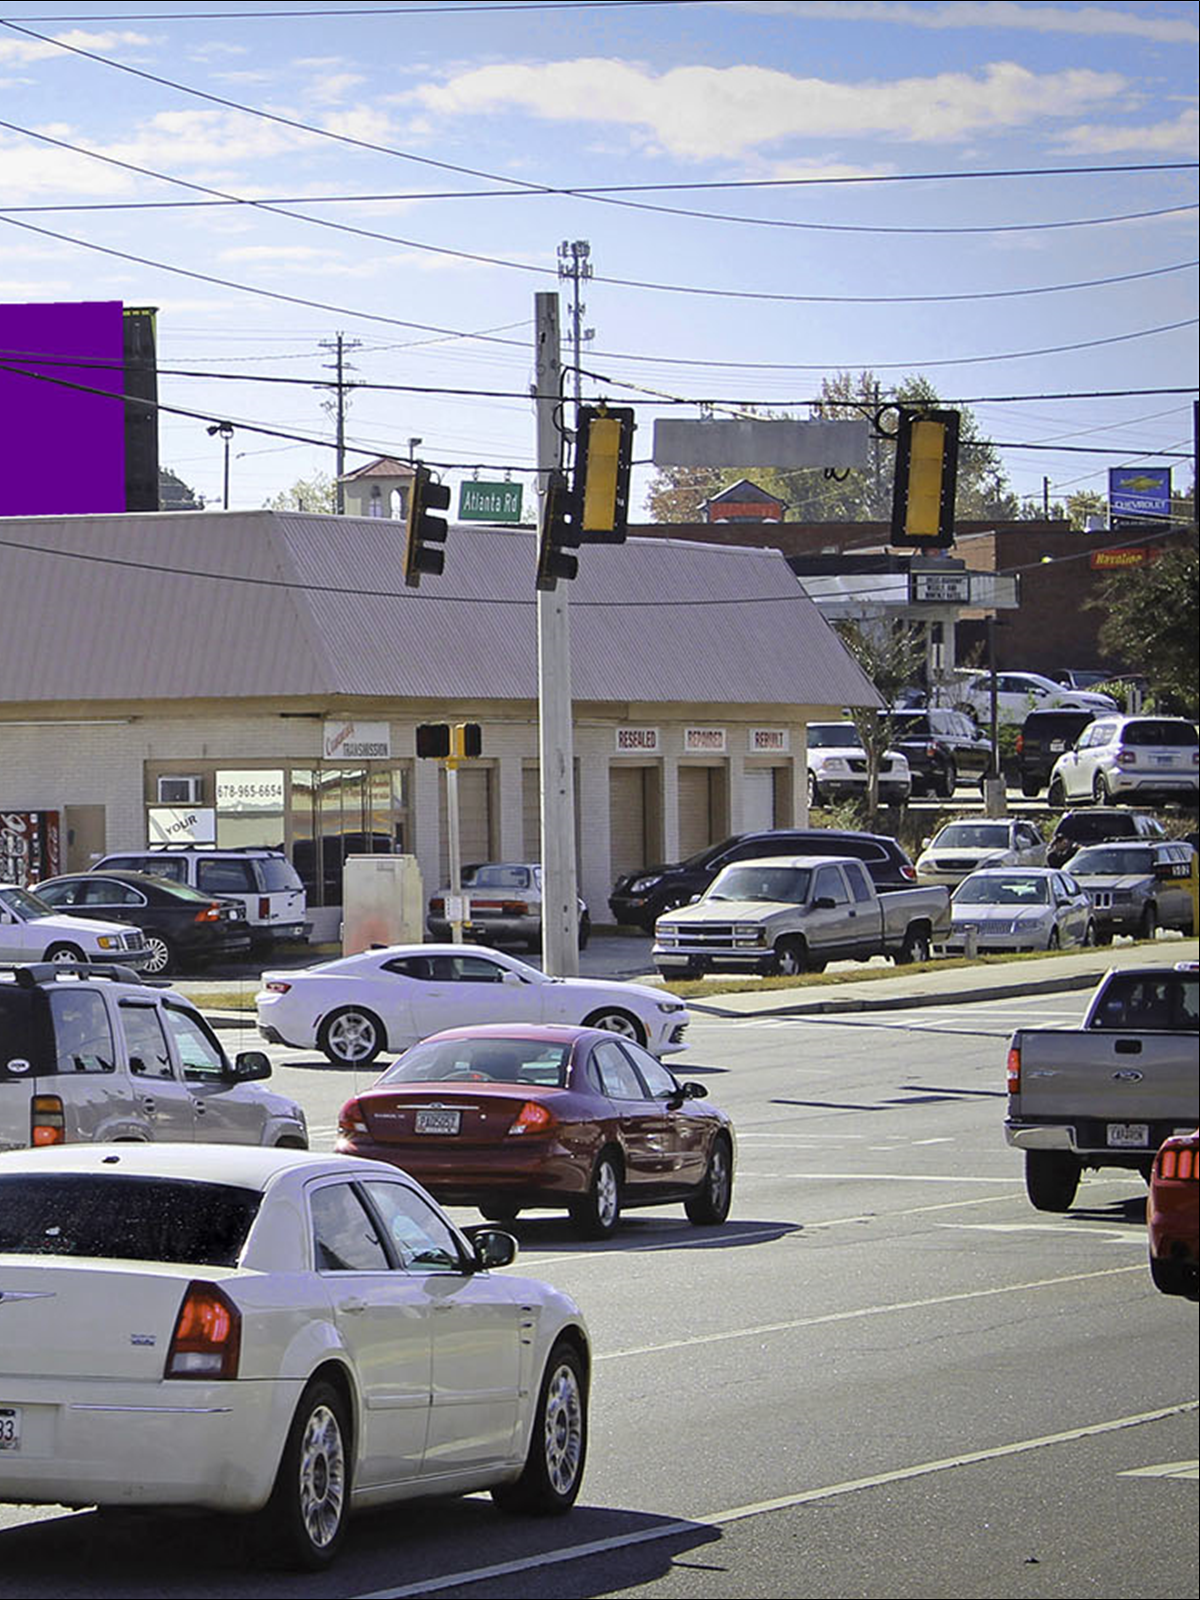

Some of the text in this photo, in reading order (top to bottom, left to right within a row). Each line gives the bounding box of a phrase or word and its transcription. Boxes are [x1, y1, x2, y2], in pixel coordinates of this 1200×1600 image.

[463, 491, 519, 513] Atlanta Rd
[618, 730, 658, 749] RESEALED
[754, 731, 785, 749] REBUILT
[164, 814, 198, 836] YOUR
